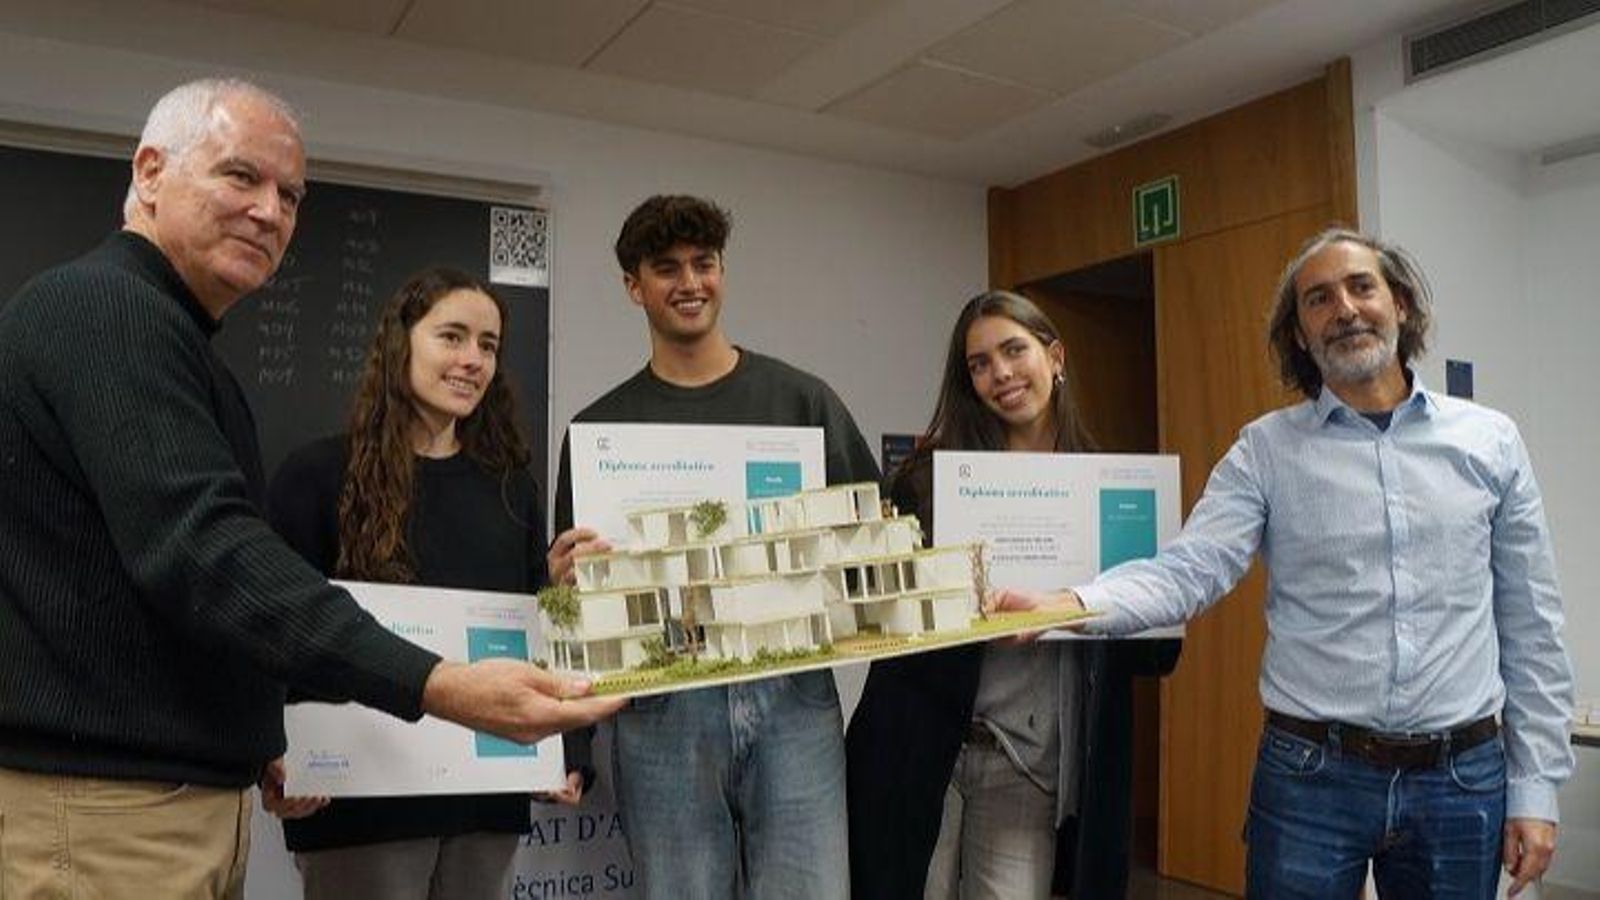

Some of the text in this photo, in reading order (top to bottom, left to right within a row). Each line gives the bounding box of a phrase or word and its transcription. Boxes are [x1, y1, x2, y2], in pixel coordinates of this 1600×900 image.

[598, 459, 647, 473] Diploma
[958, 484, 1006, 499] Diploma
[526, 811, 625, 846] AT D'A
[513, 863, 634, 900] ècnica Su
